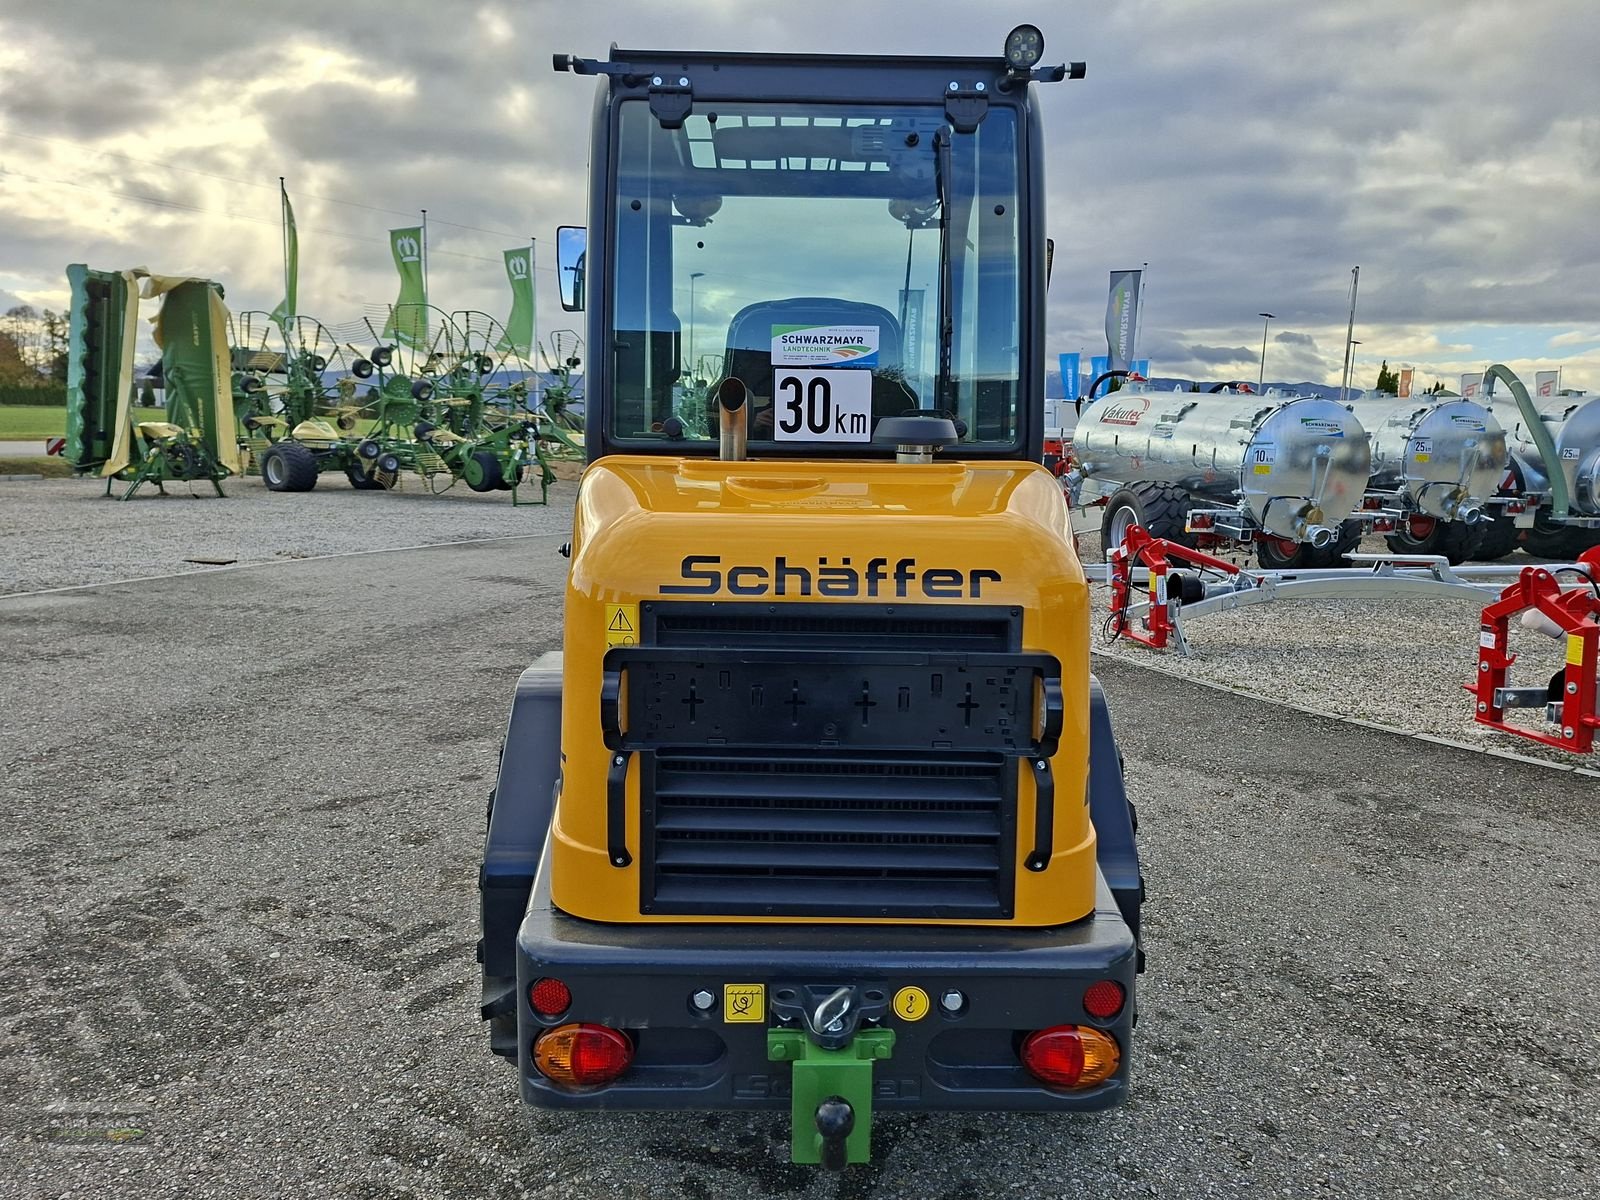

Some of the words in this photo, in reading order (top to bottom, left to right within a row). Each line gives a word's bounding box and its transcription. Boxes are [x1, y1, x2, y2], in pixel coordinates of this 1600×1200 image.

[781, 335, 863, 344] SCHWARZMAYR
[1099, 402, 1145, 423] Vakutec
[1415, 441, 1425, 452] 25
[1254, 449, 1266, 462] 10
[1563, 449, 1573, 458] 25
[659, 555, 1002, 598] Schäffer
